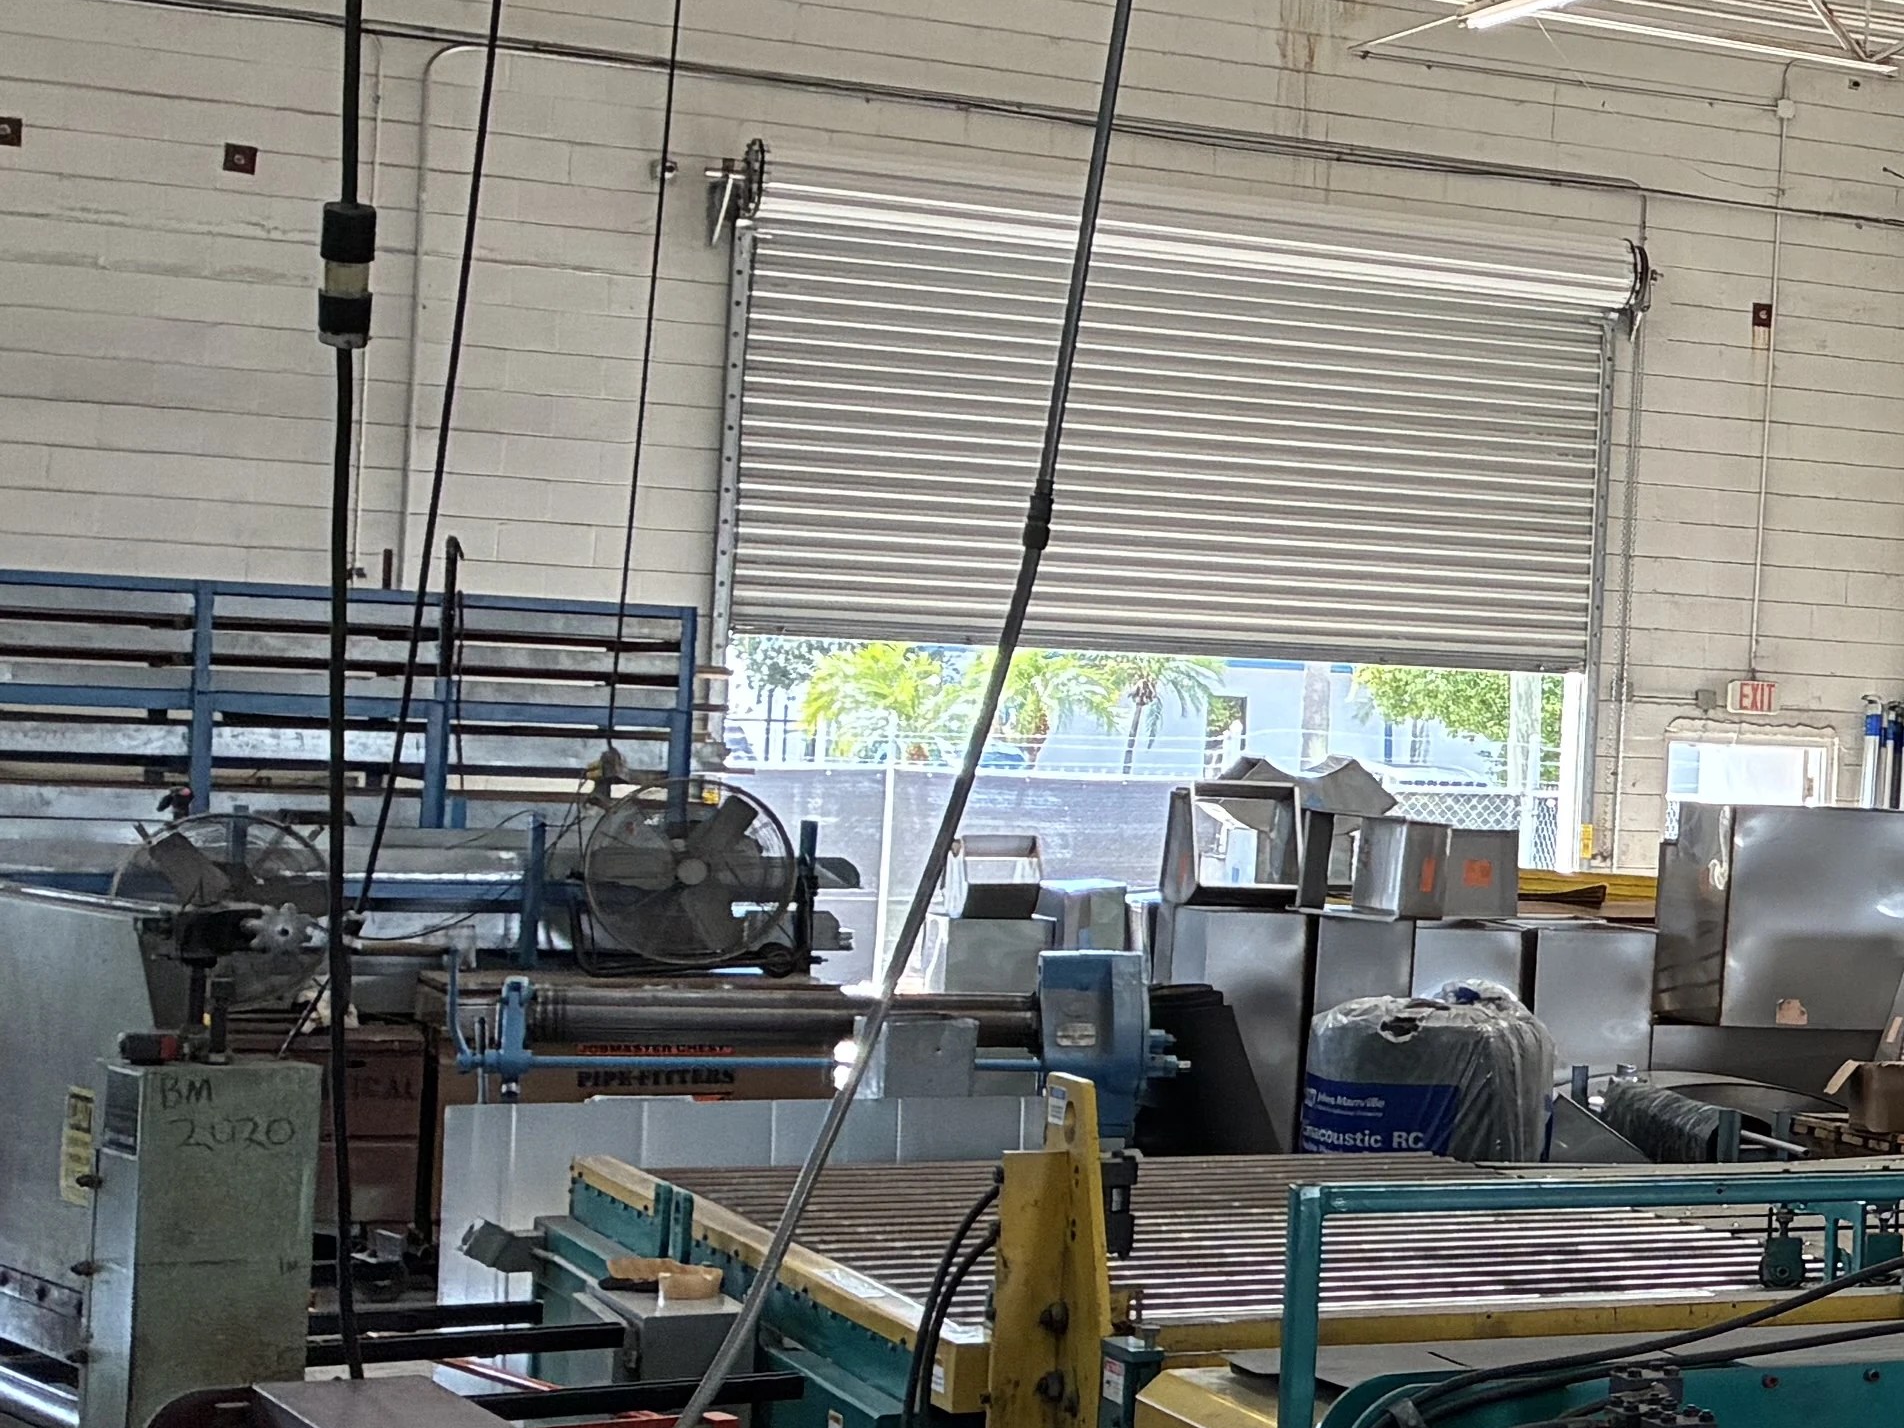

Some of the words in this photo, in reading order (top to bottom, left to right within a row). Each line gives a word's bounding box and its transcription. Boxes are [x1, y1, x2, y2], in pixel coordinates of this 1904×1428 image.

[1739, 682, 1775, 712] EXIT
[160, 1073, 213, 1111] BM
[1392, 1131, 1424, 1149] RC
